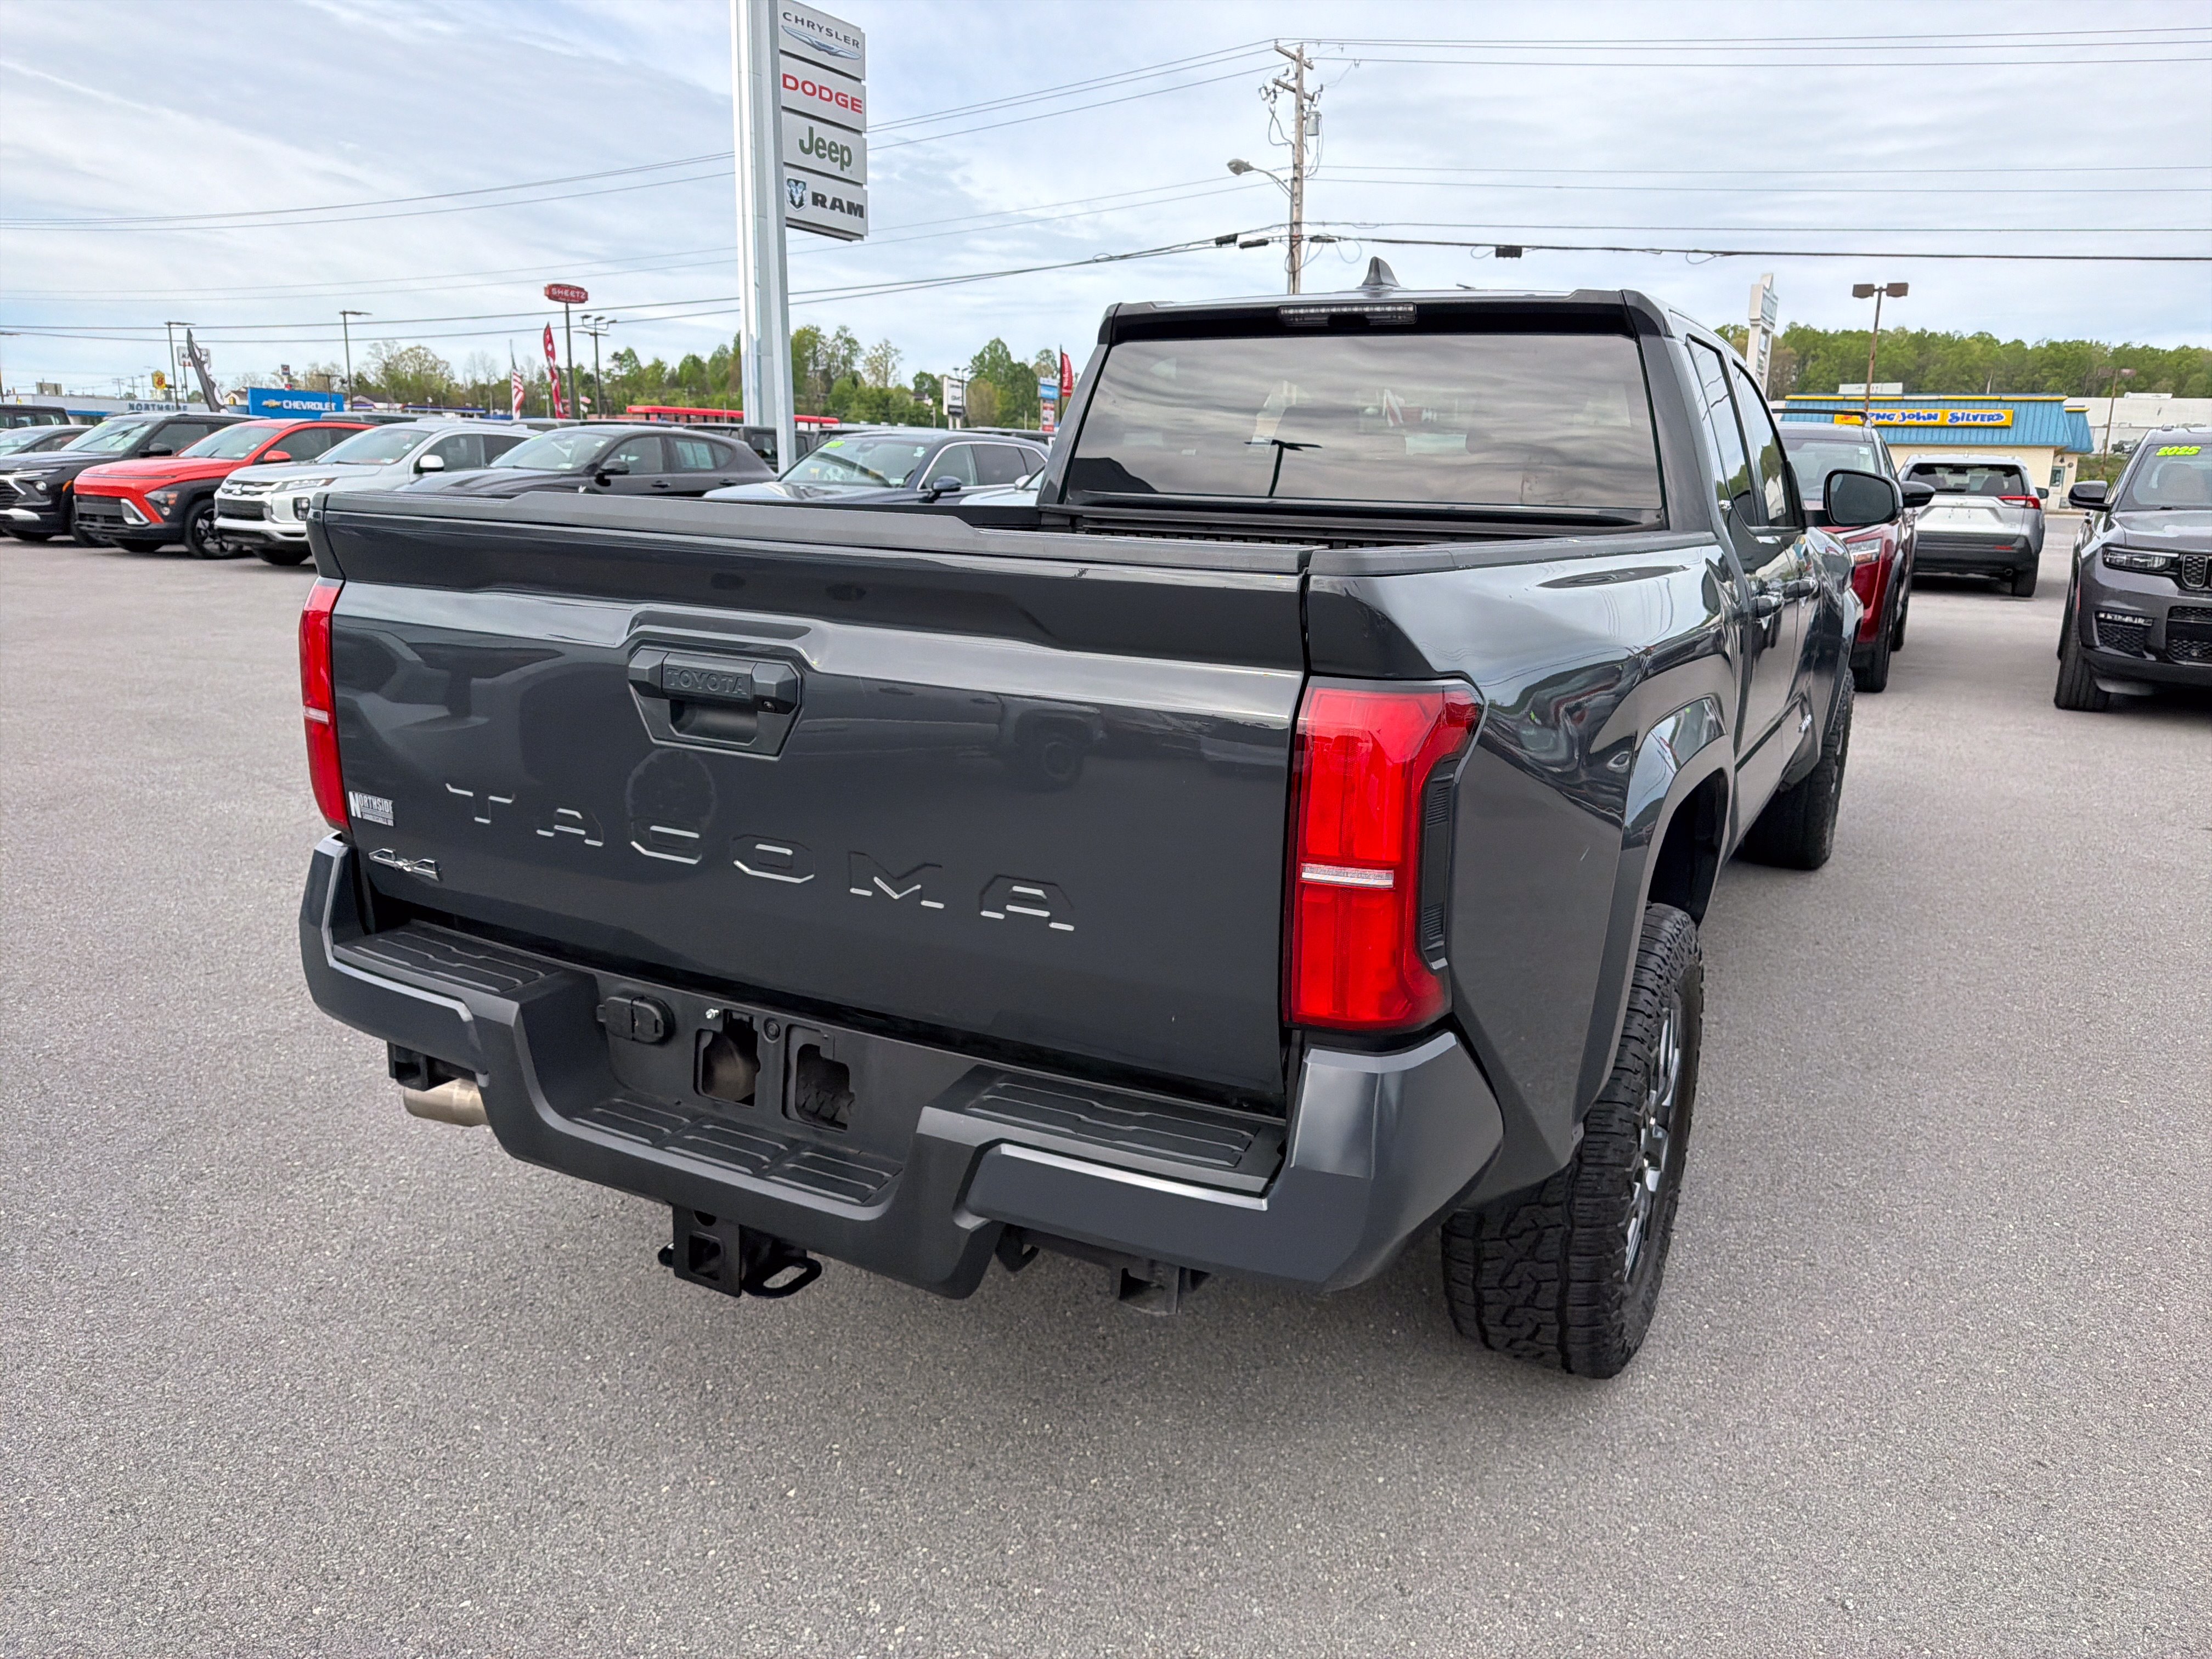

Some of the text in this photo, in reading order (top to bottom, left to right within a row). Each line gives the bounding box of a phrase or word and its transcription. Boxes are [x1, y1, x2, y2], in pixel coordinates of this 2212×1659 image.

[782, 12, 860, 49] CHRYSLER
[782, 73, 863, 115] DODGE
[799, 126, 852, 172] Jeep
[811, 191, 865, 219] RAM
[551, 287, 586, 299] SHEETZ
[128, 402, 188, 411] NORTHSIDE
[283, 399, 336, 411] CHEVROLET
[2155, 445, 2202, 456] 2025
[666, 668, 747, 695] TOYOTA
[445, 782, 1075, 932] TACOMA
